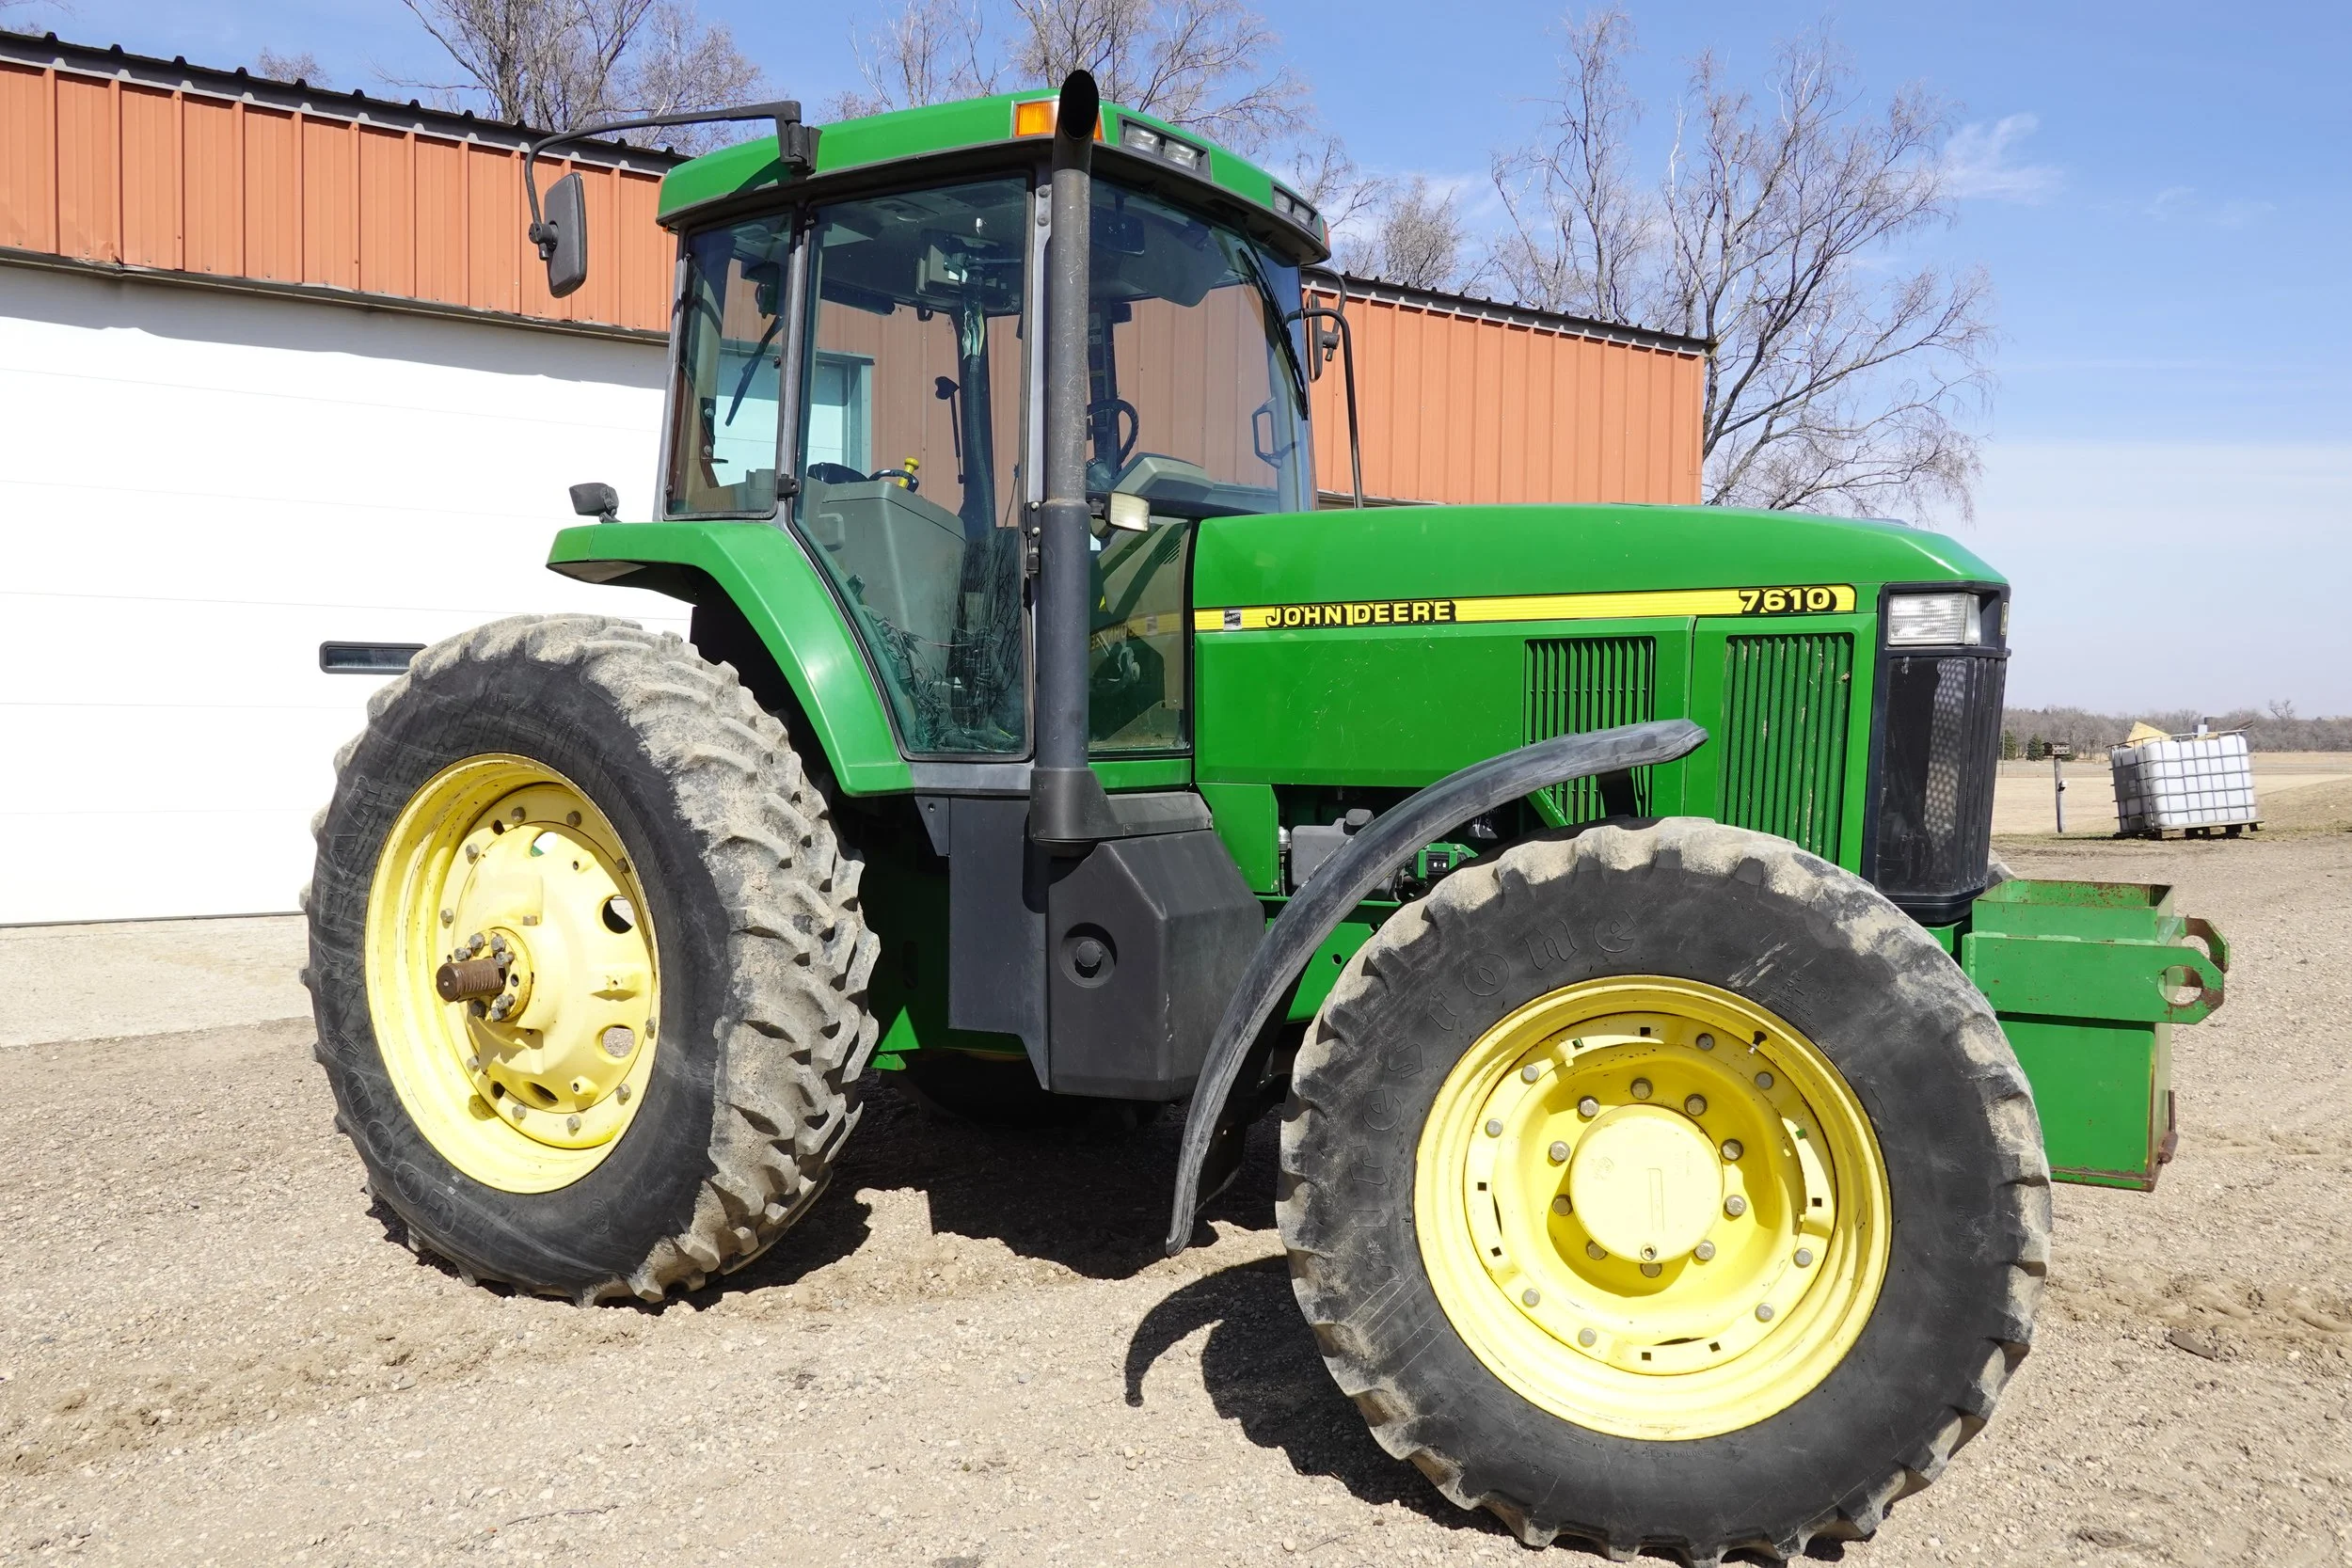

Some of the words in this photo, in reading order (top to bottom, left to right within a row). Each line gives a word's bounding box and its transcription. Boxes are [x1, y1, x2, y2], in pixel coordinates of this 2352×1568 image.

[1739, 587, 1836, 613] 7610
[1265, 605, 1347, 627] JOHN
[1352, 600, 1455, 625] DEERE
